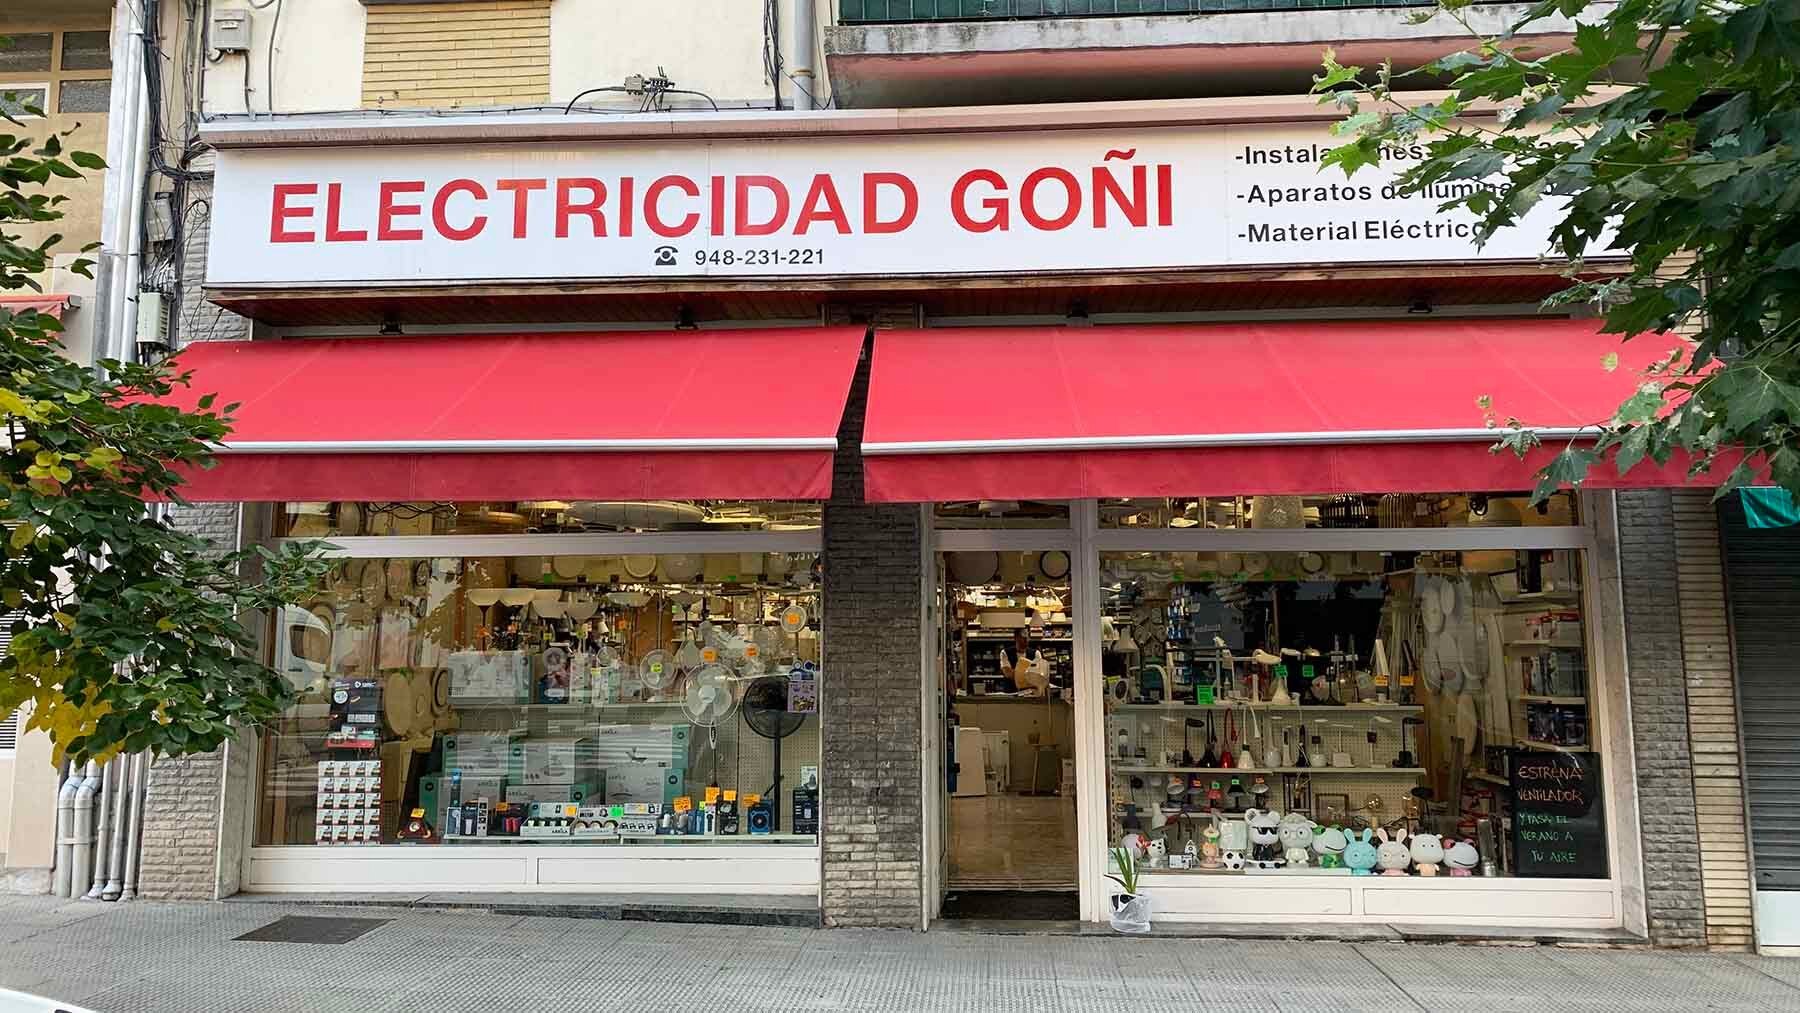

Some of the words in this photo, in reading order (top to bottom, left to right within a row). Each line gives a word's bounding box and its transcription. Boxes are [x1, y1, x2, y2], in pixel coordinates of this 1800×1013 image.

[1236, 143, 1423, 164] -Instalanes
[270, 172, 919, 243] ELECTRICIDAD
[951, 148, 1172, 233] GOÑI
[1237, 183, 1372, 206] -Aparatos
[1238, 221, 1357, 242] -Material
[695, 248, 823, 266] 948-231-221
[1519, 766, 1582, 780] ESTRENA
[1518, 788, 1584, 804] VENTILADOR
[1520, 830, 1559, 841] VERANO
[1565, 831, 1574, 841] A
